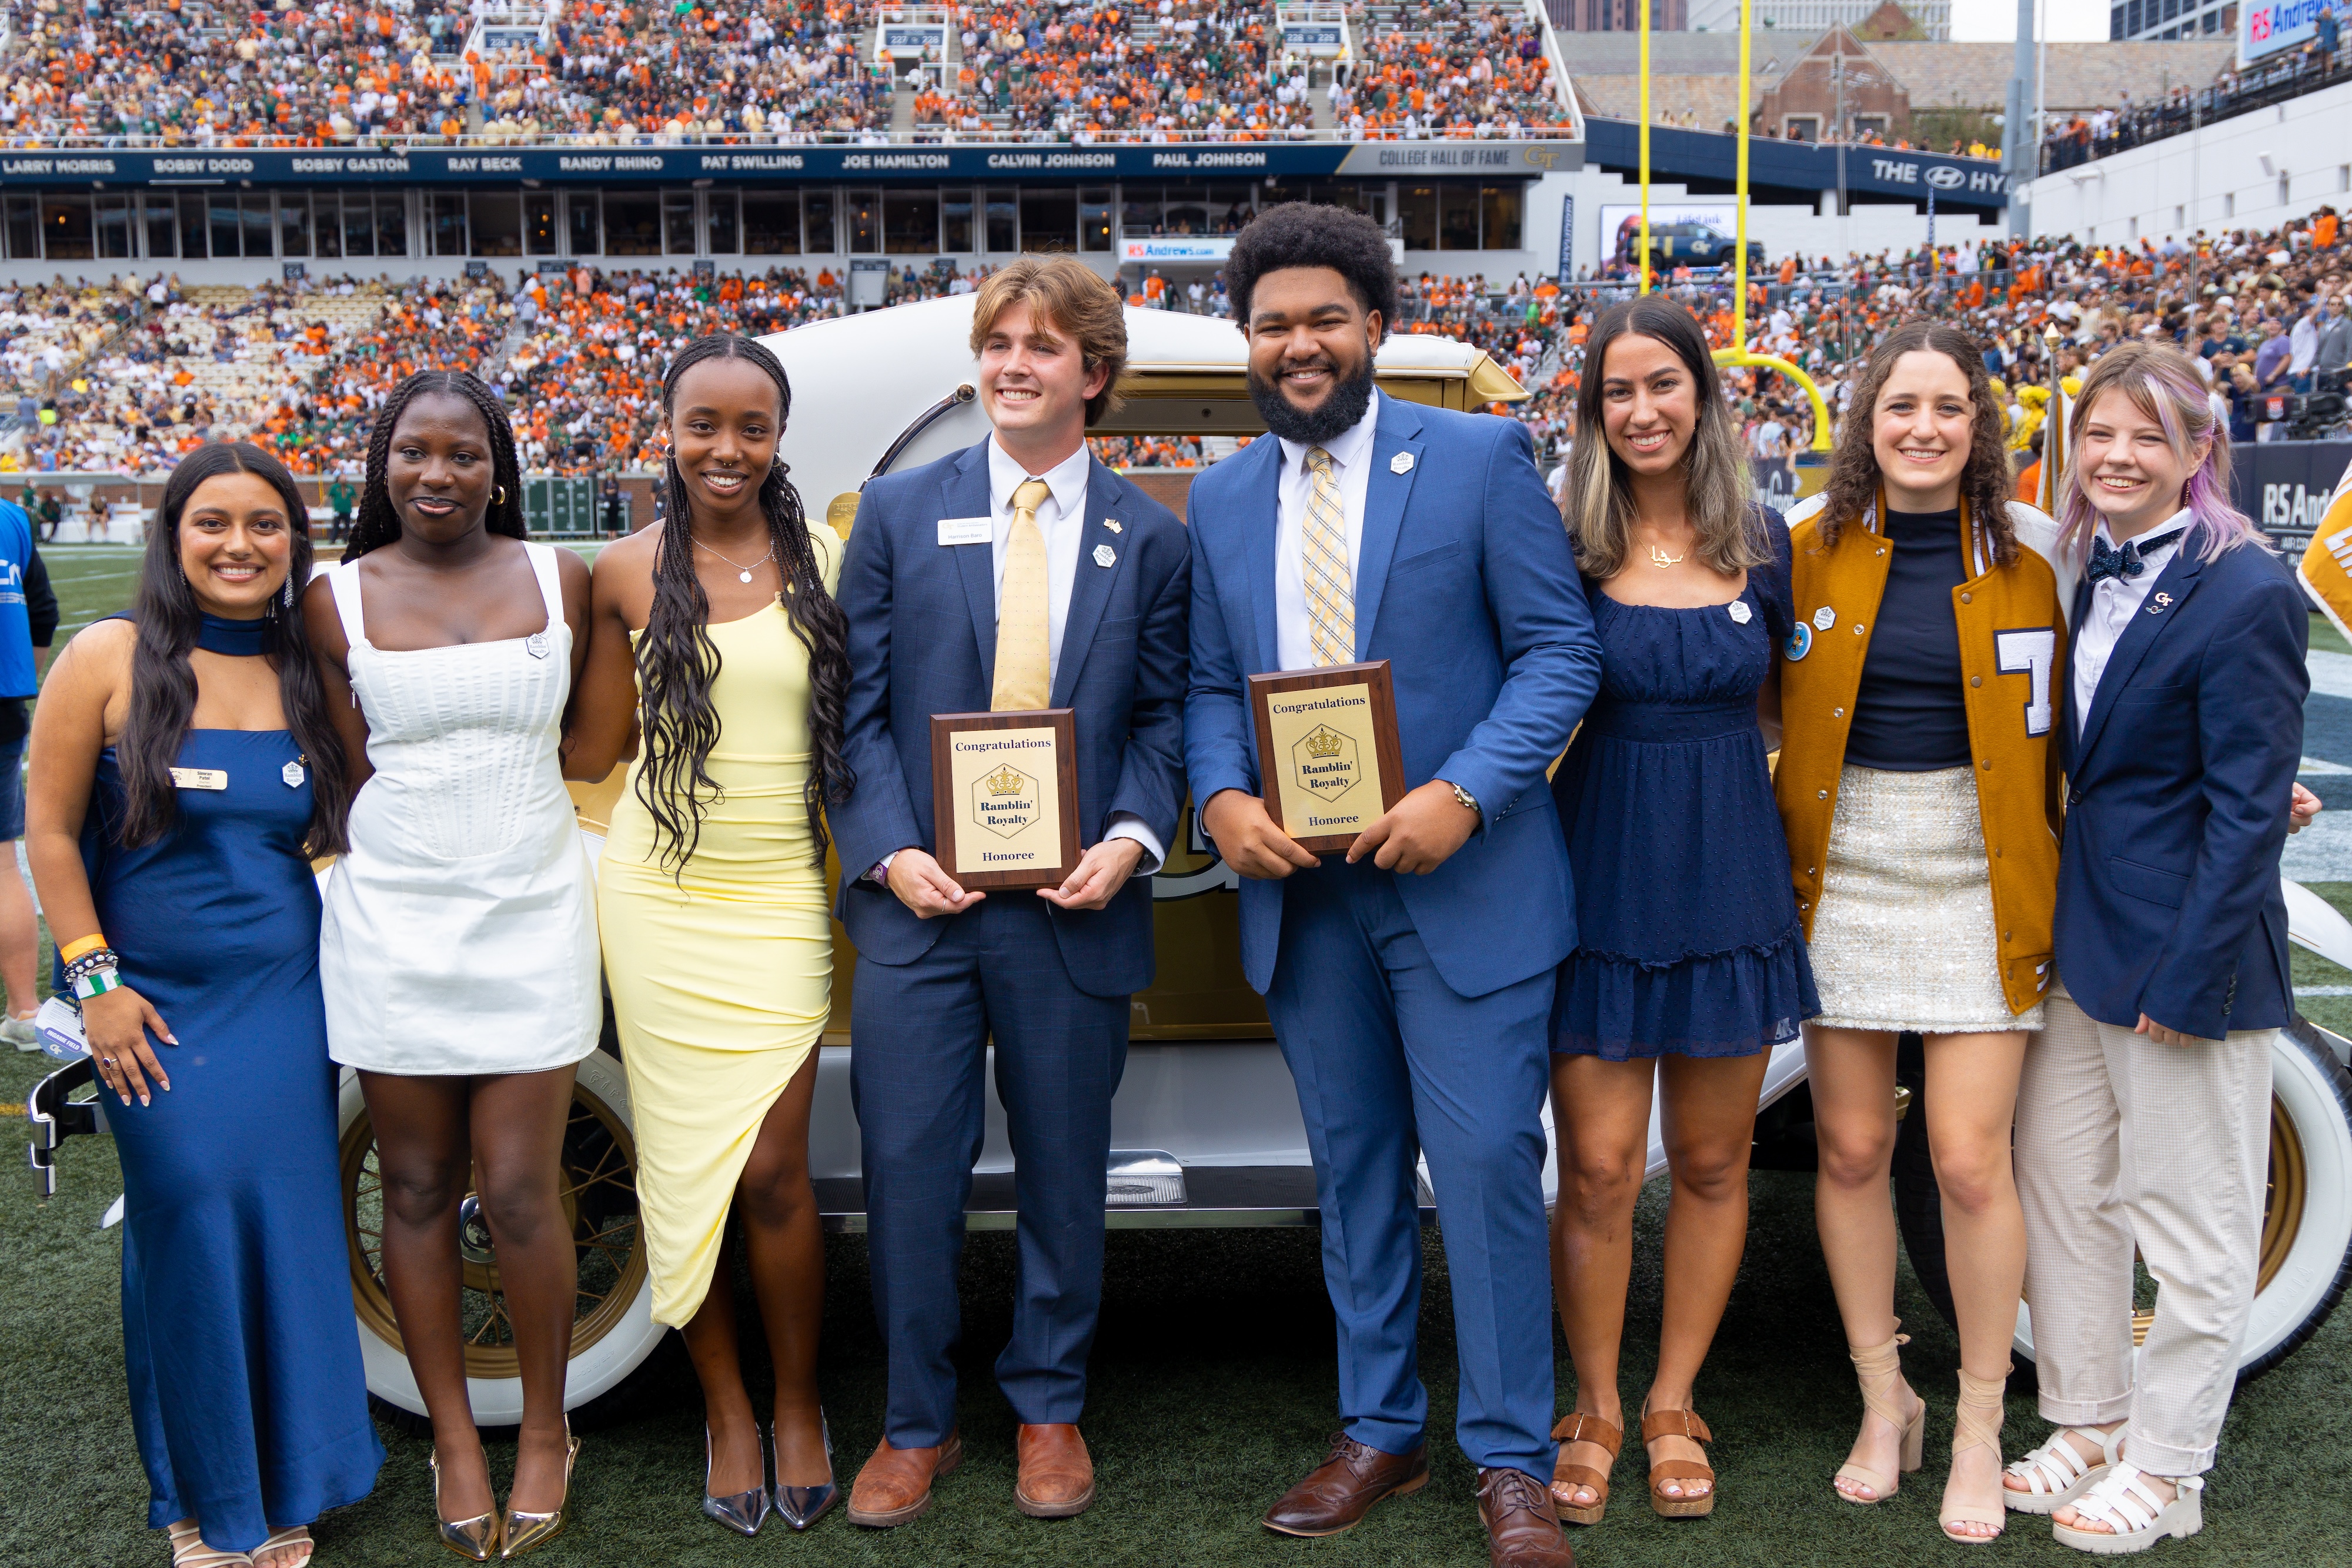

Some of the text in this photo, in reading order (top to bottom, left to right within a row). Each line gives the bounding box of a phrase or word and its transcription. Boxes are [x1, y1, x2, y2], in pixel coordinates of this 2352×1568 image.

[447, 156, 522, 171] RAY BECK
[560, 156, 663, 170] RANDY RHINO
[701, 155, 804, 169] PAT SWILLING
[841, 155, 949, 168] JOE HAMILTON
[988, 153, 1115, 168] CALVIN JOHNSON
[1153, 152, 1267, 167] PAUL JOHNSON
[1380, 149, 1510, 165] COLLEGE HALL OF FAME
[1524, 146, 1560, 168] GT
[2, 159, 116, 173] LARRY MORRIS
[153, 159, 254, 173] BOBBY DODD
[292, 158, 410, 172] BOBBY GASTON
[1872, 158, 1919, 184] THE
[2155, 592, 2173, 606] GT
[1273, 697, 1365, 714] Congratulations
[956, 738, 1051, 753] Congratulations
[1302, 761, 1352, 774] Ramblin'
[1309, 777, 1349, 789] Royalty
[980, 800, 1033, 811] Ramblin'
[987, 815, 1028, 826] Royalty
[1309, 815, 1359, 826] Honoree
[983, 852, 1035, 861] Honoree
[46, 1029, 80, 1051] INGAME FIELD
